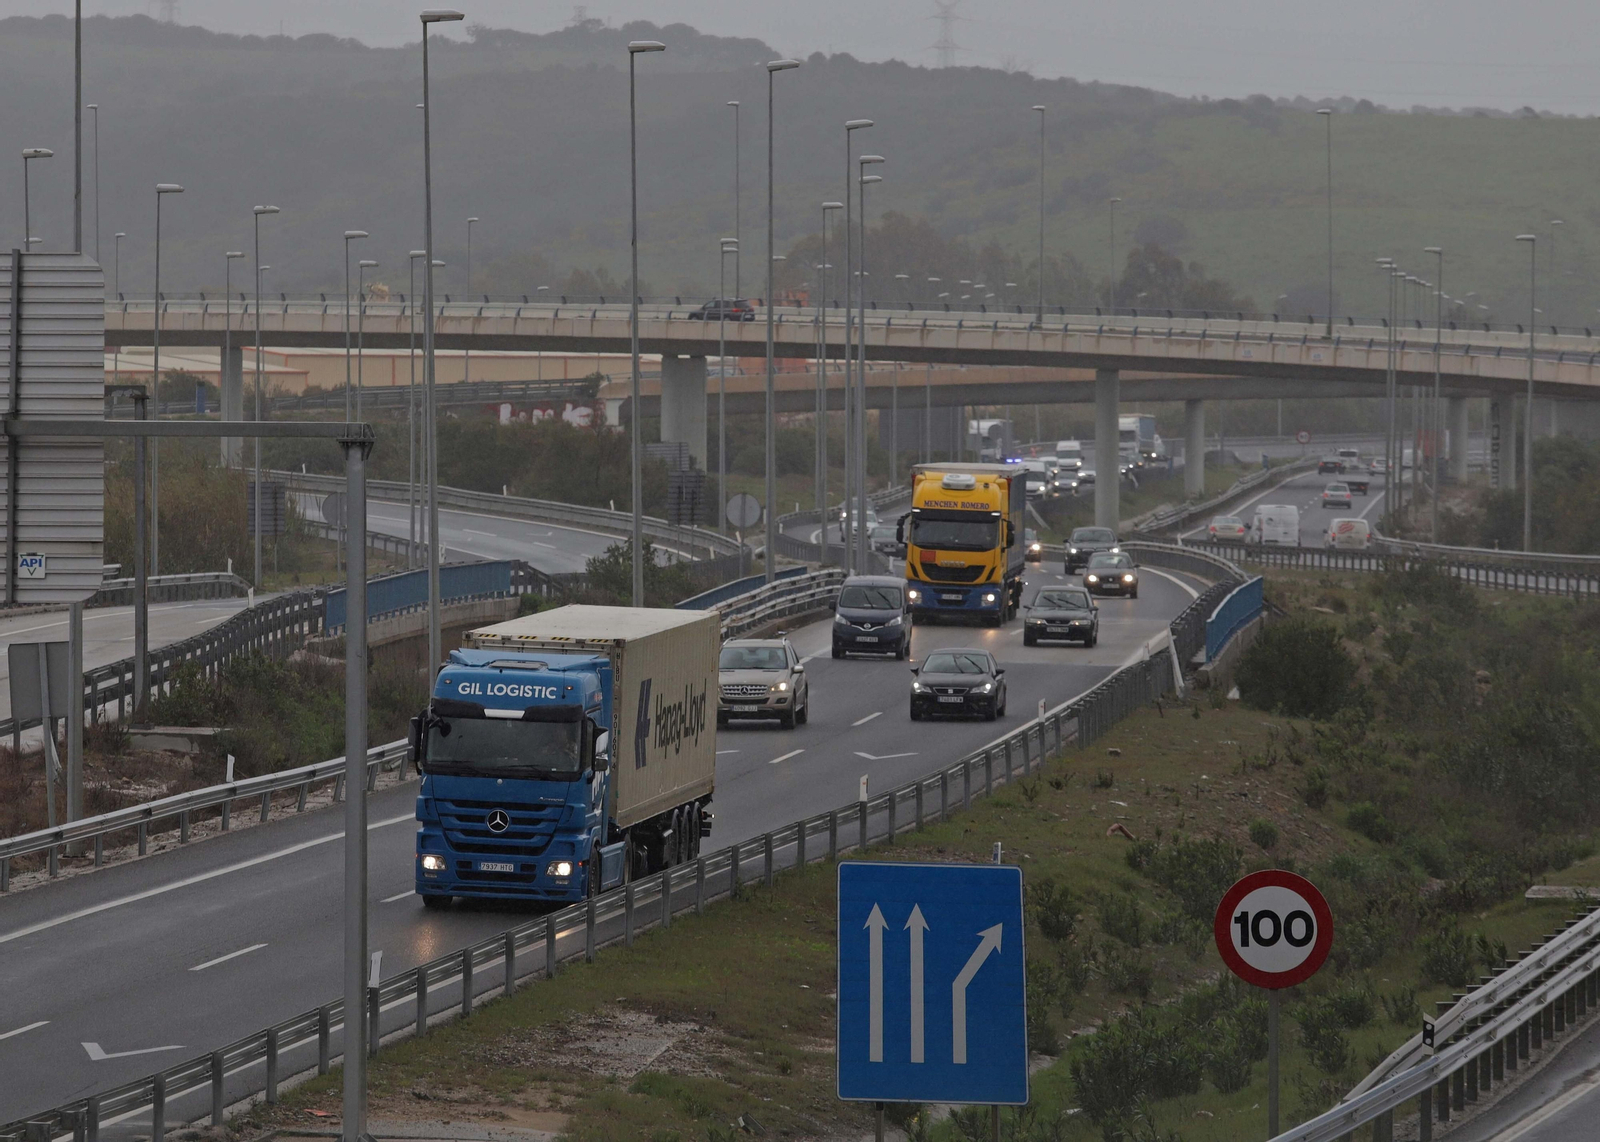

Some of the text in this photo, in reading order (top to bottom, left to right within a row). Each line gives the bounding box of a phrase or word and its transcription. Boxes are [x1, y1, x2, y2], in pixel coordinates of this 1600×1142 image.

[923, 500, 989, 510] MENCHEN ROMERO
[20, 558, 42, 568] API
[458, 682, 557, 699] GIL LOGISTIC
[654, 678, 707, 760] Hapag-Lloyd
[481, 863, 498, 871] 7937
[1234, 909, 1314, 948] 100
